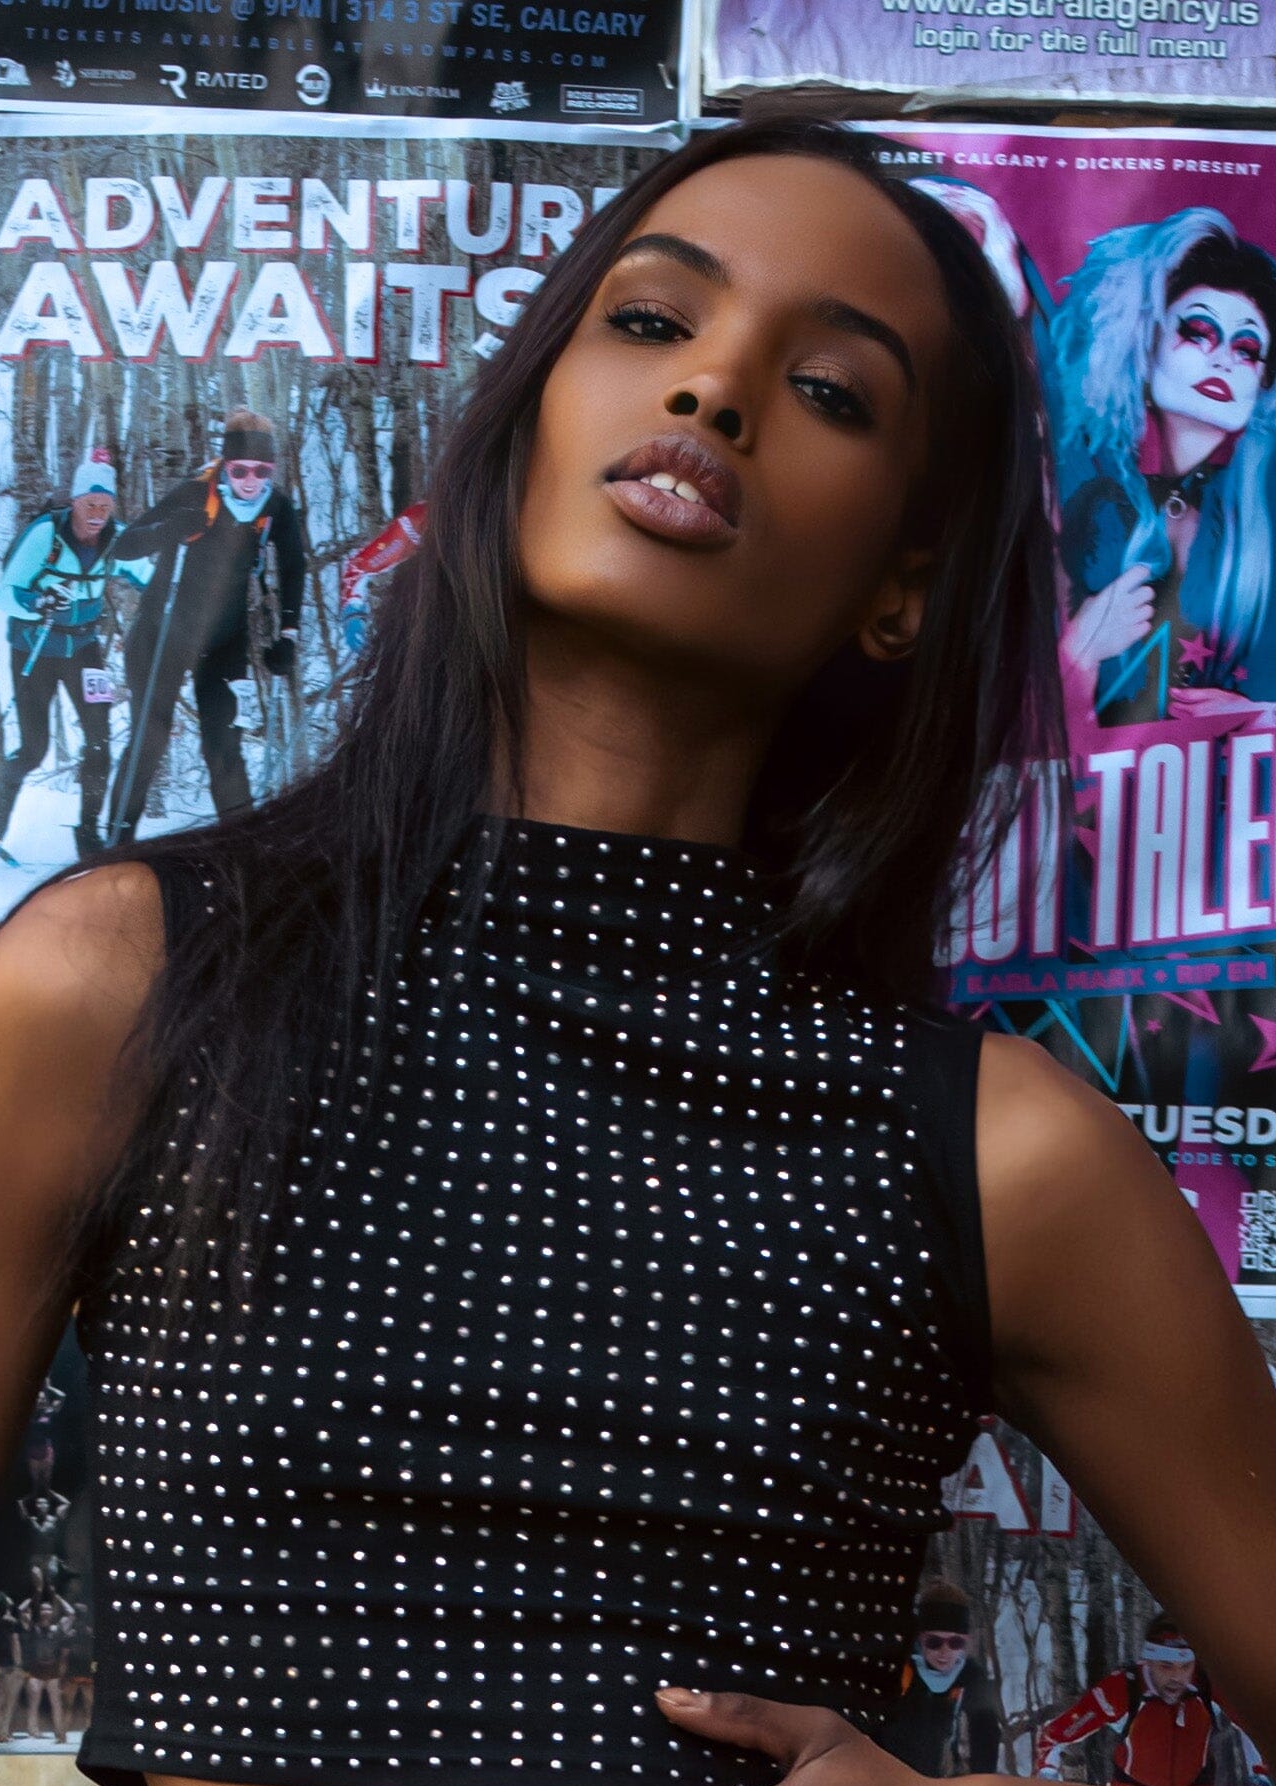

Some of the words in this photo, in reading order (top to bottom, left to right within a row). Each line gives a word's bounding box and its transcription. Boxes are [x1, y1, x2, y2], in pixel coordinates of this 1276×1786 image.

[954, 151, 1048, 169] CALGARY
[1075, 156, 1165, 173] DICKENS
[1172, 159, 1262, 176] PRESENT
